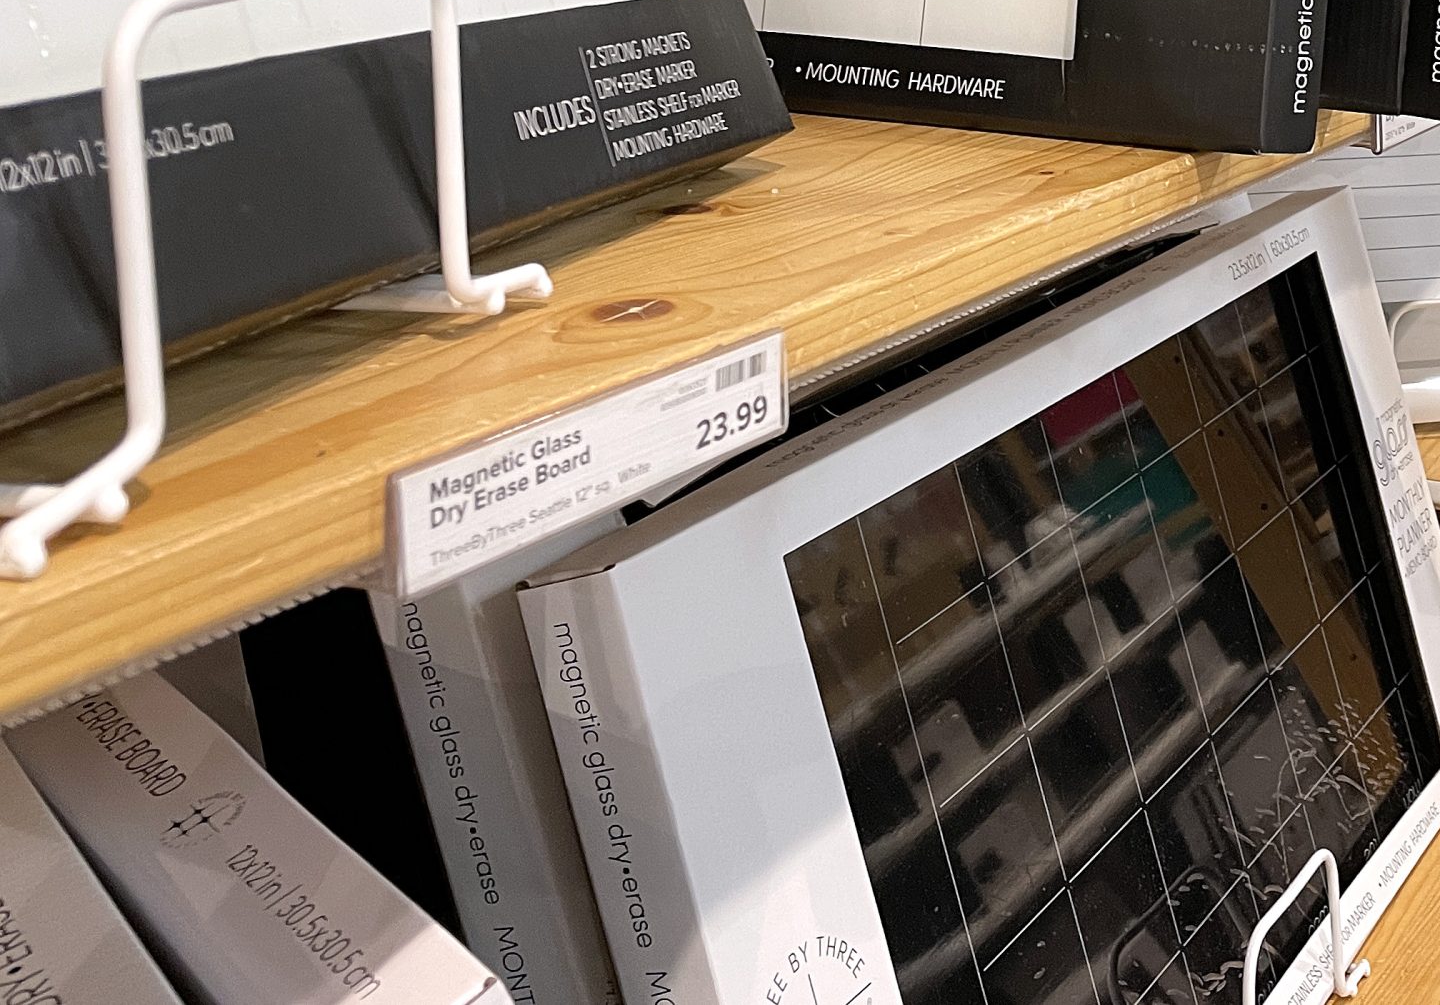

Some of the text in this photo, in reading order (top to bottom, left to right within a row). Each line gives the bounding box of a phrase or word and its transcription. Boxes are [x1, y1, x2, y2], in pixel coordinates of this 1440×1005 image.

[586, 31, 691, 69] 2 STRONG MAGNETS
[655, 59, 697, 86] MARKER
[602, 102, 659, 131] STAINLESS
[658, 91, 688, 117] SHELF
[701, 80, 742, 104] MARKER
[805, 61, 900, 89] MOUNTING
[908, 72, 1006, 100] HARDWARE
[514, 95, 597, 140] INCLUDES
[612, 112, 729, 161] MOUNTING HARDWARE
[695, 395, 768, 450] 23.99
[429, 429, 582, 503] Magnetic Glass
[430, 445, 591, 529] Dry Erase Board
[429, 516, 527, 567] ThreeByThree
[527, 495, 572, 526] Seattle
[618, 461, 652, 484] White
[1389, 477, 1425, 528] MONTHLY
[1397, 507, 1433, 559] PLANNER
[115, 739, 187, 796] BOARD
[553, 622, 652, 948] magnetic glass dry•erase
[429, 716, 465, 778] glass
[454, 785, 500, 904] dry•erase
[1382, 802, 1440, 888] MOUNTING HARDWARE
[225, 844, 282, 900] 12x12in
[276, 895, 381, 1000] 30.5x30.5cm
[1348, 892, 1376, 931] MARKER
[788, 936, 865, 979] BY THREE
